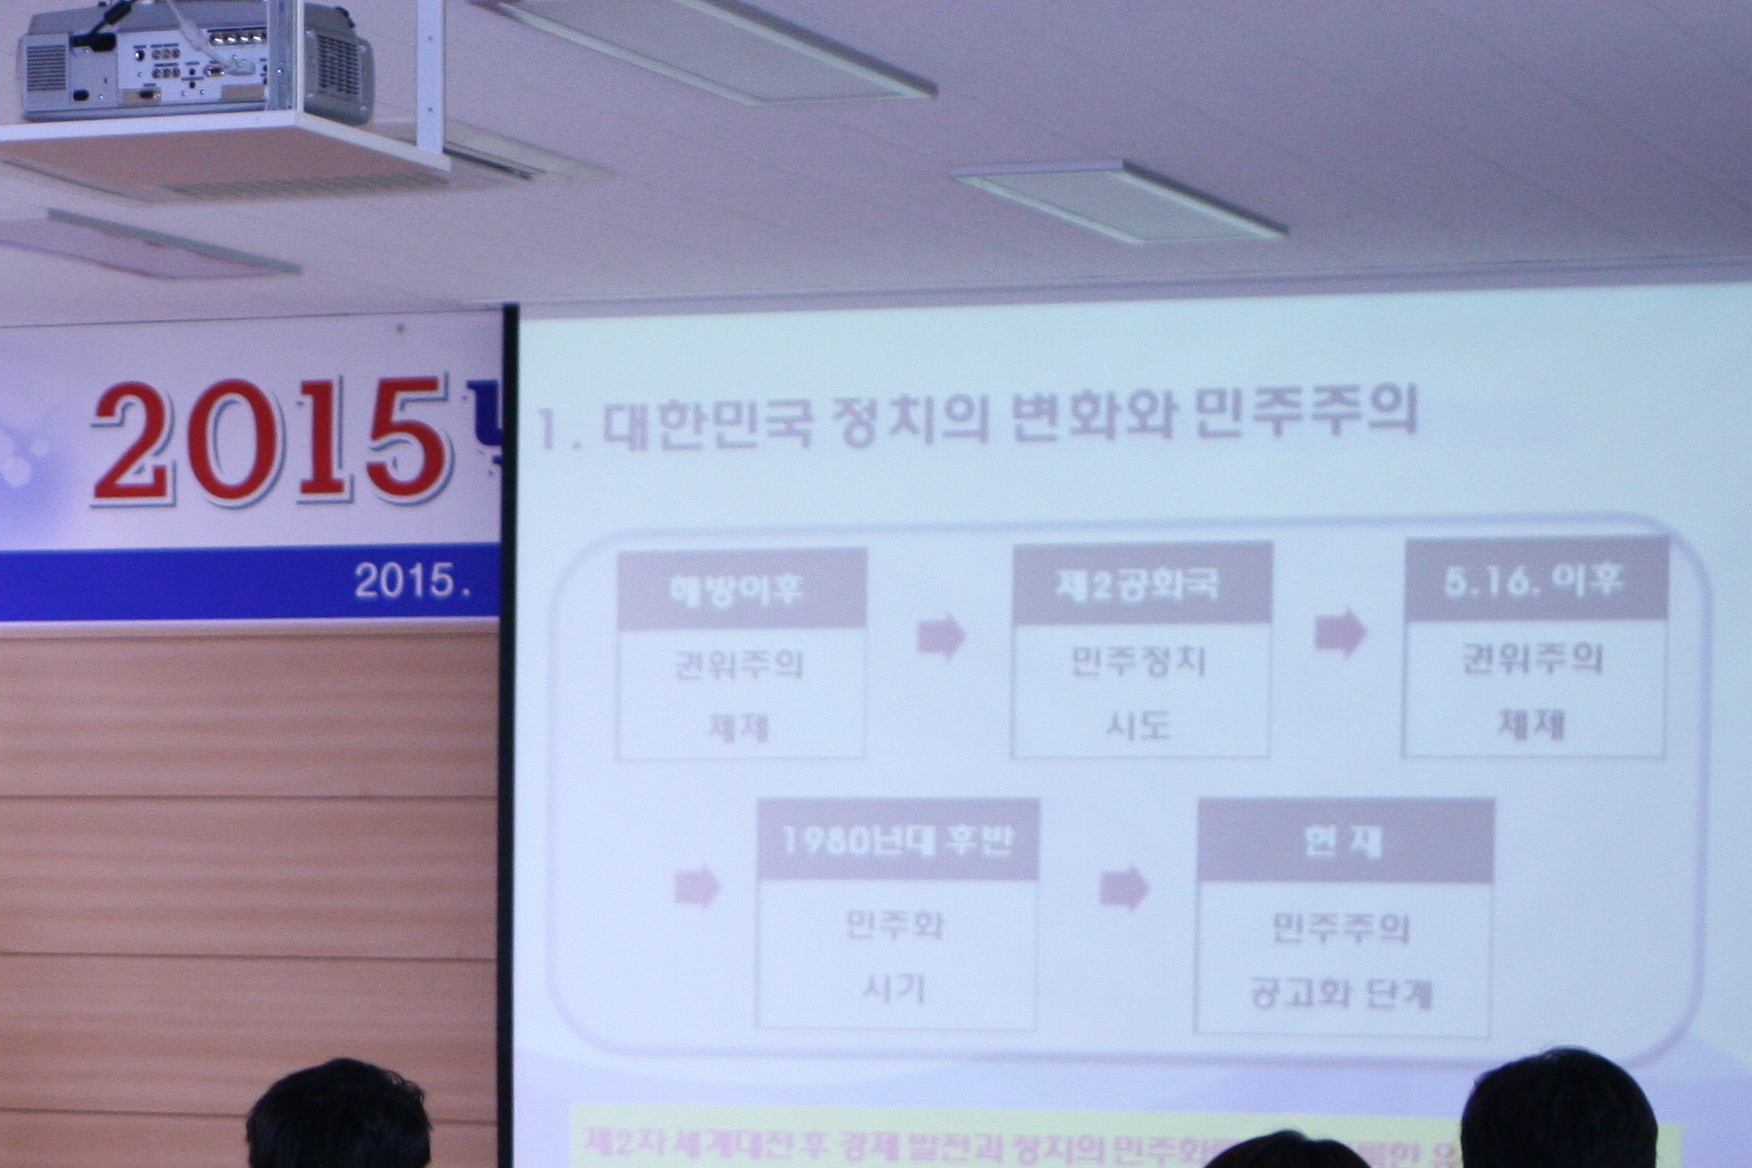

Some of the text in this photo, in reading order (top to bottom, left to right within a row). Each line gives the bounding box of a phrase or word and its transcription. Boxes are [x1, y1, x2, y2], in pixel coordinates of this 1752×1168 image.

[538, 382, 1418, 452] 1. 대한민국 정치의 변화와 민주주의
[354, 561, 471, 598] 2015.
[669, 572, 804, 608] 해방이후
[1054, 566, 1220, 604] 제2공화국
[1444, 561, 1625, 599] 5.16. 이후
[675, 648, 804, 682] 권위주의
[1072, 644, 1206, 678] 민주정치
[1462, 641, 1604, 675] 권위주의
[1106, 710, 1171, 742] 시도
[782, 822, 1015, 858] 1980년대 후반
[846, 909, 946, 941] 민주화
[1273, 912, 1410, 944] 민주주의
[861, 973, 926, 1005] 시기
[1250, 976, 1434, 1011] 공고화 단계
[1011, 1133, 1106, 1168] 정치의
